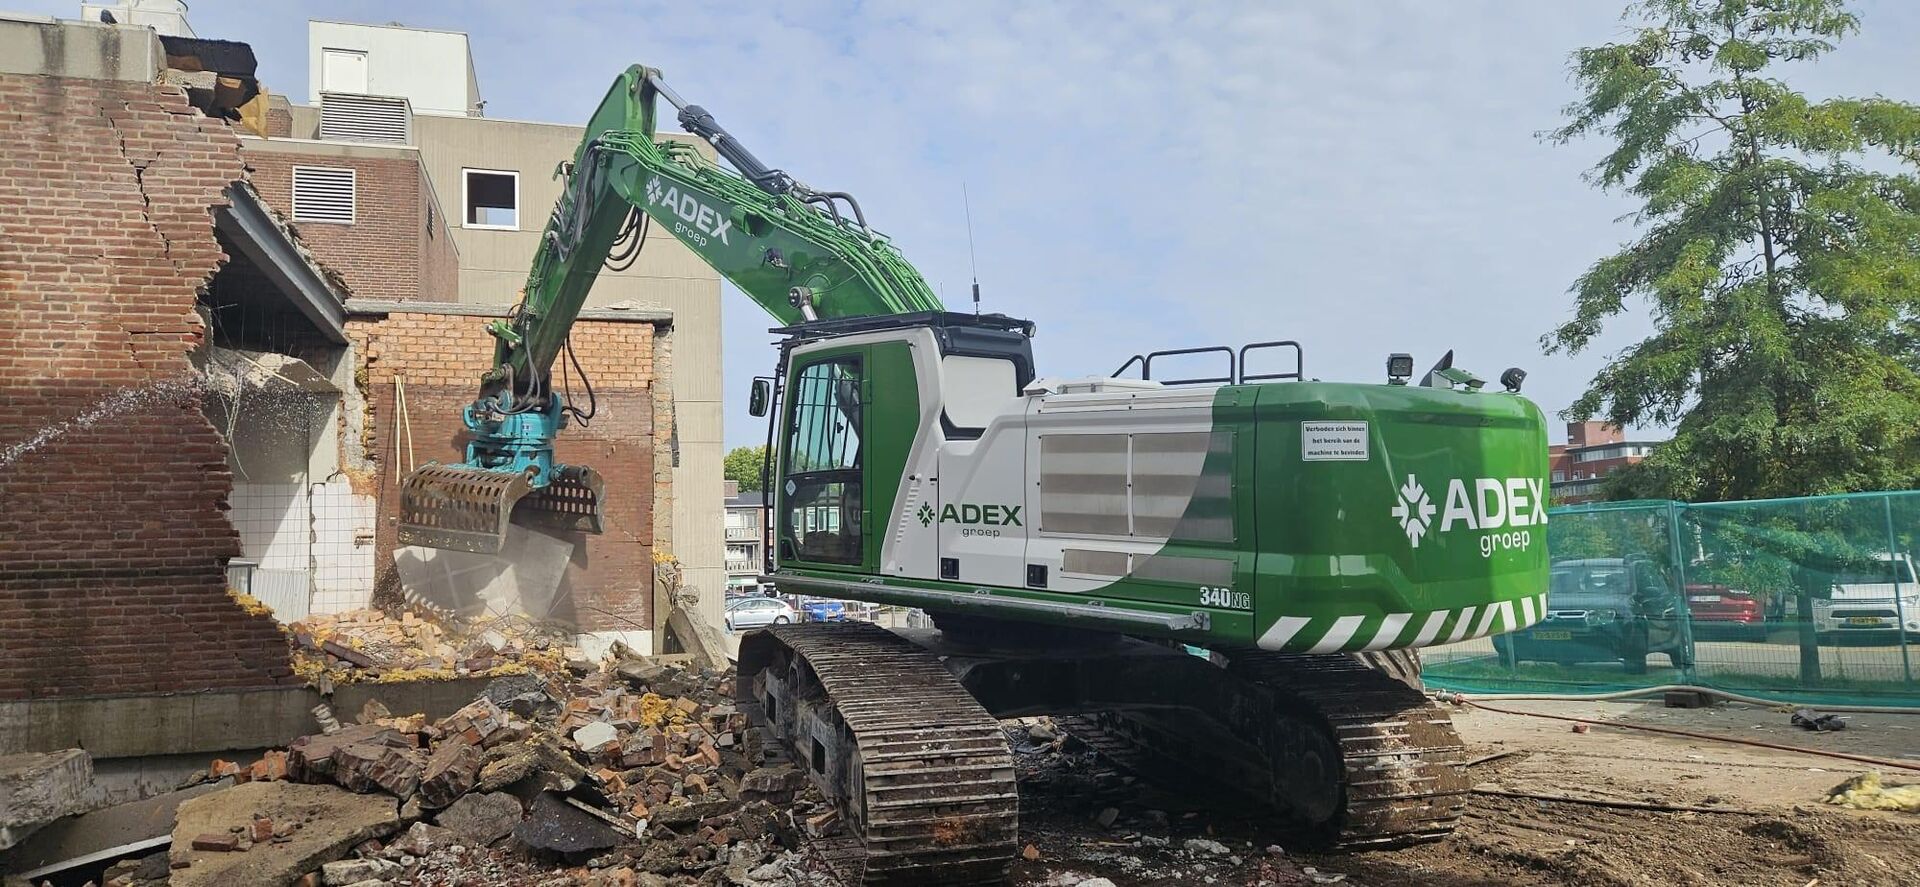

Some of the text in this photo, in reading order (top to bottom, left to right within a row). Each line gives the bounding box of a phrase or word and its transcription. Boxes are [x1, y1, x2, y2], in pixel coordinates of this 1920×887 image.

[661, 186, 732, 246] ADEX
[675, 222, 707, 247] groep
[939, 503, 1023, 526] ADEX
[1440, 478, 1548, 531] ADEX
[962, 528, 1000, 539] groep
[1480, 530, 1530, 557] groep
